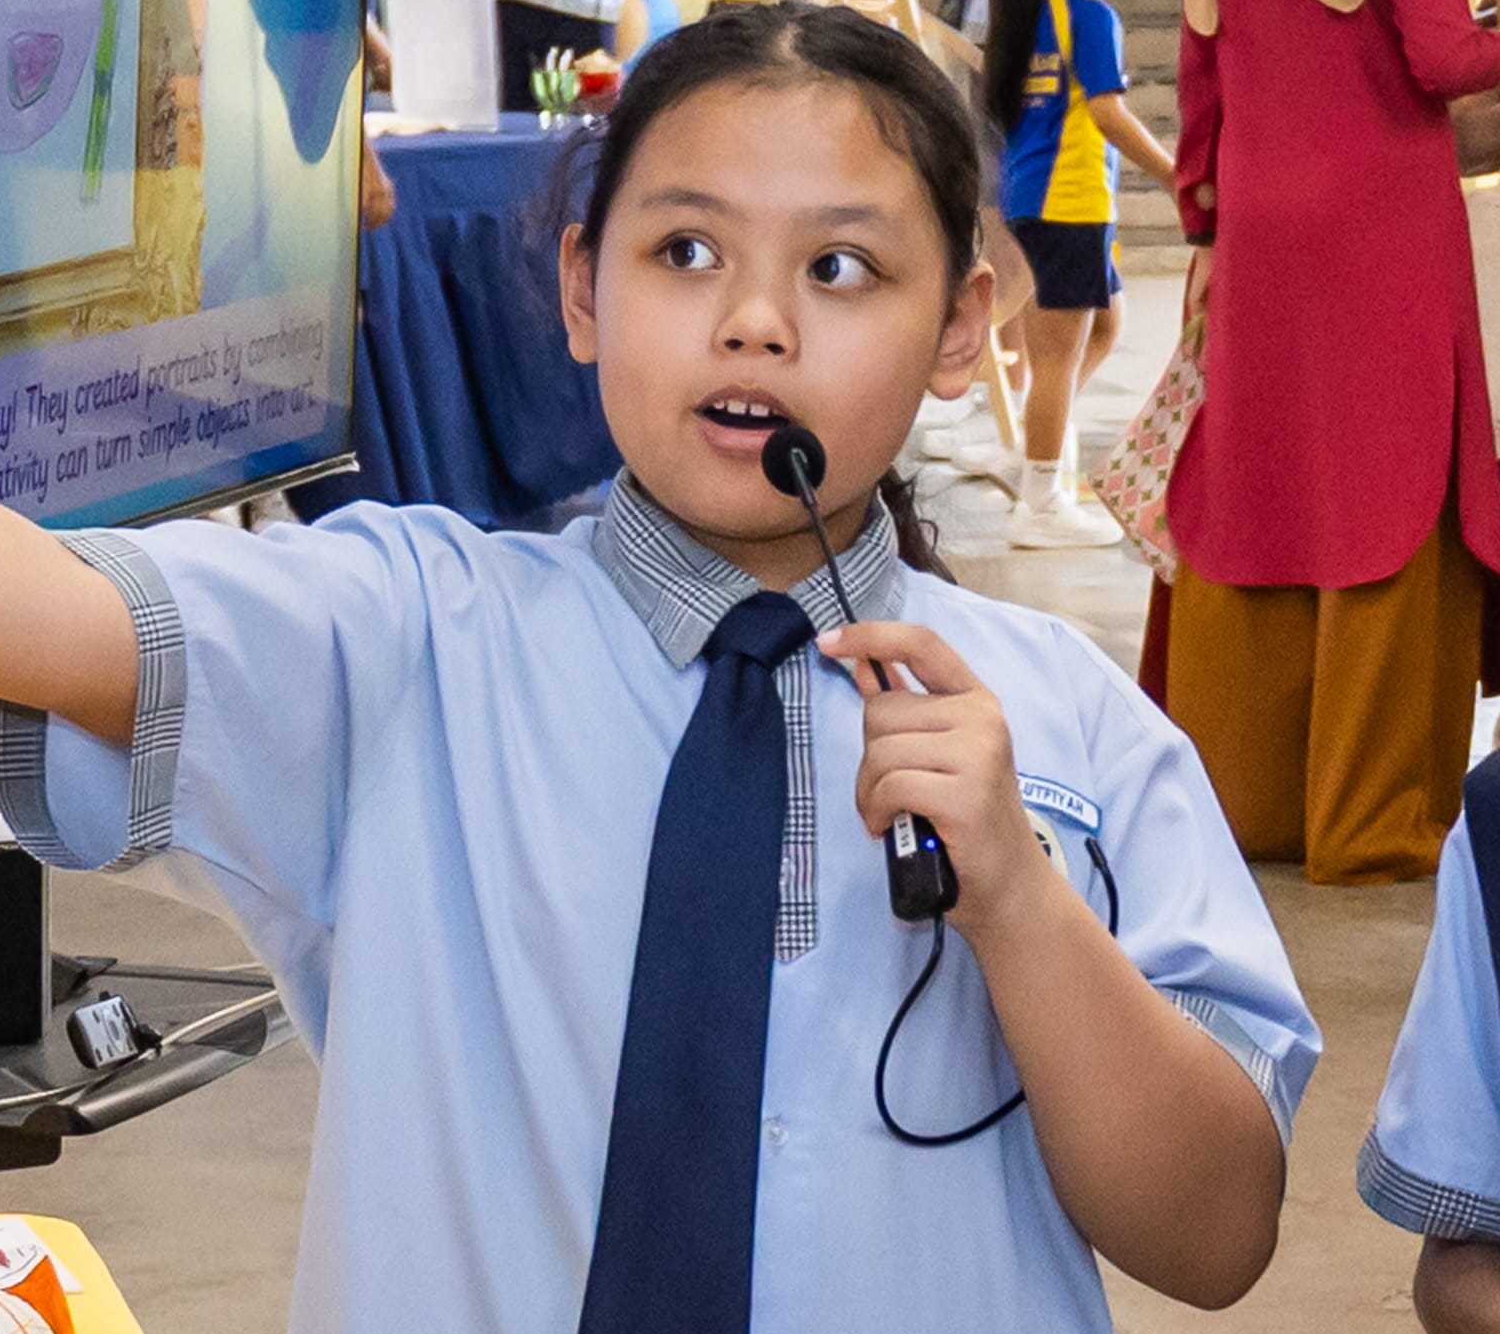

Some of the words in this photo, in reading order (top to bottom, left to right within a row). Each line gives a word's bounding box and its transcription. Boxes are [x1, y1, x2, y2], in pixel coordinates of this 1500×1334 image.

[25, 382, 68, 434] They
[74, 355, 141, 415] created
[146, 342, 218, 408] portraits
[223, 336, 243, 385] by
[249, 318, 323, 367] combining
[56, 445, 88, 483] can
[95, 434, 132, 471] turn
[138, 406, 191, 464] simple
[197, 398, 251, 450] objects
[256, 386, 285, 426] into
